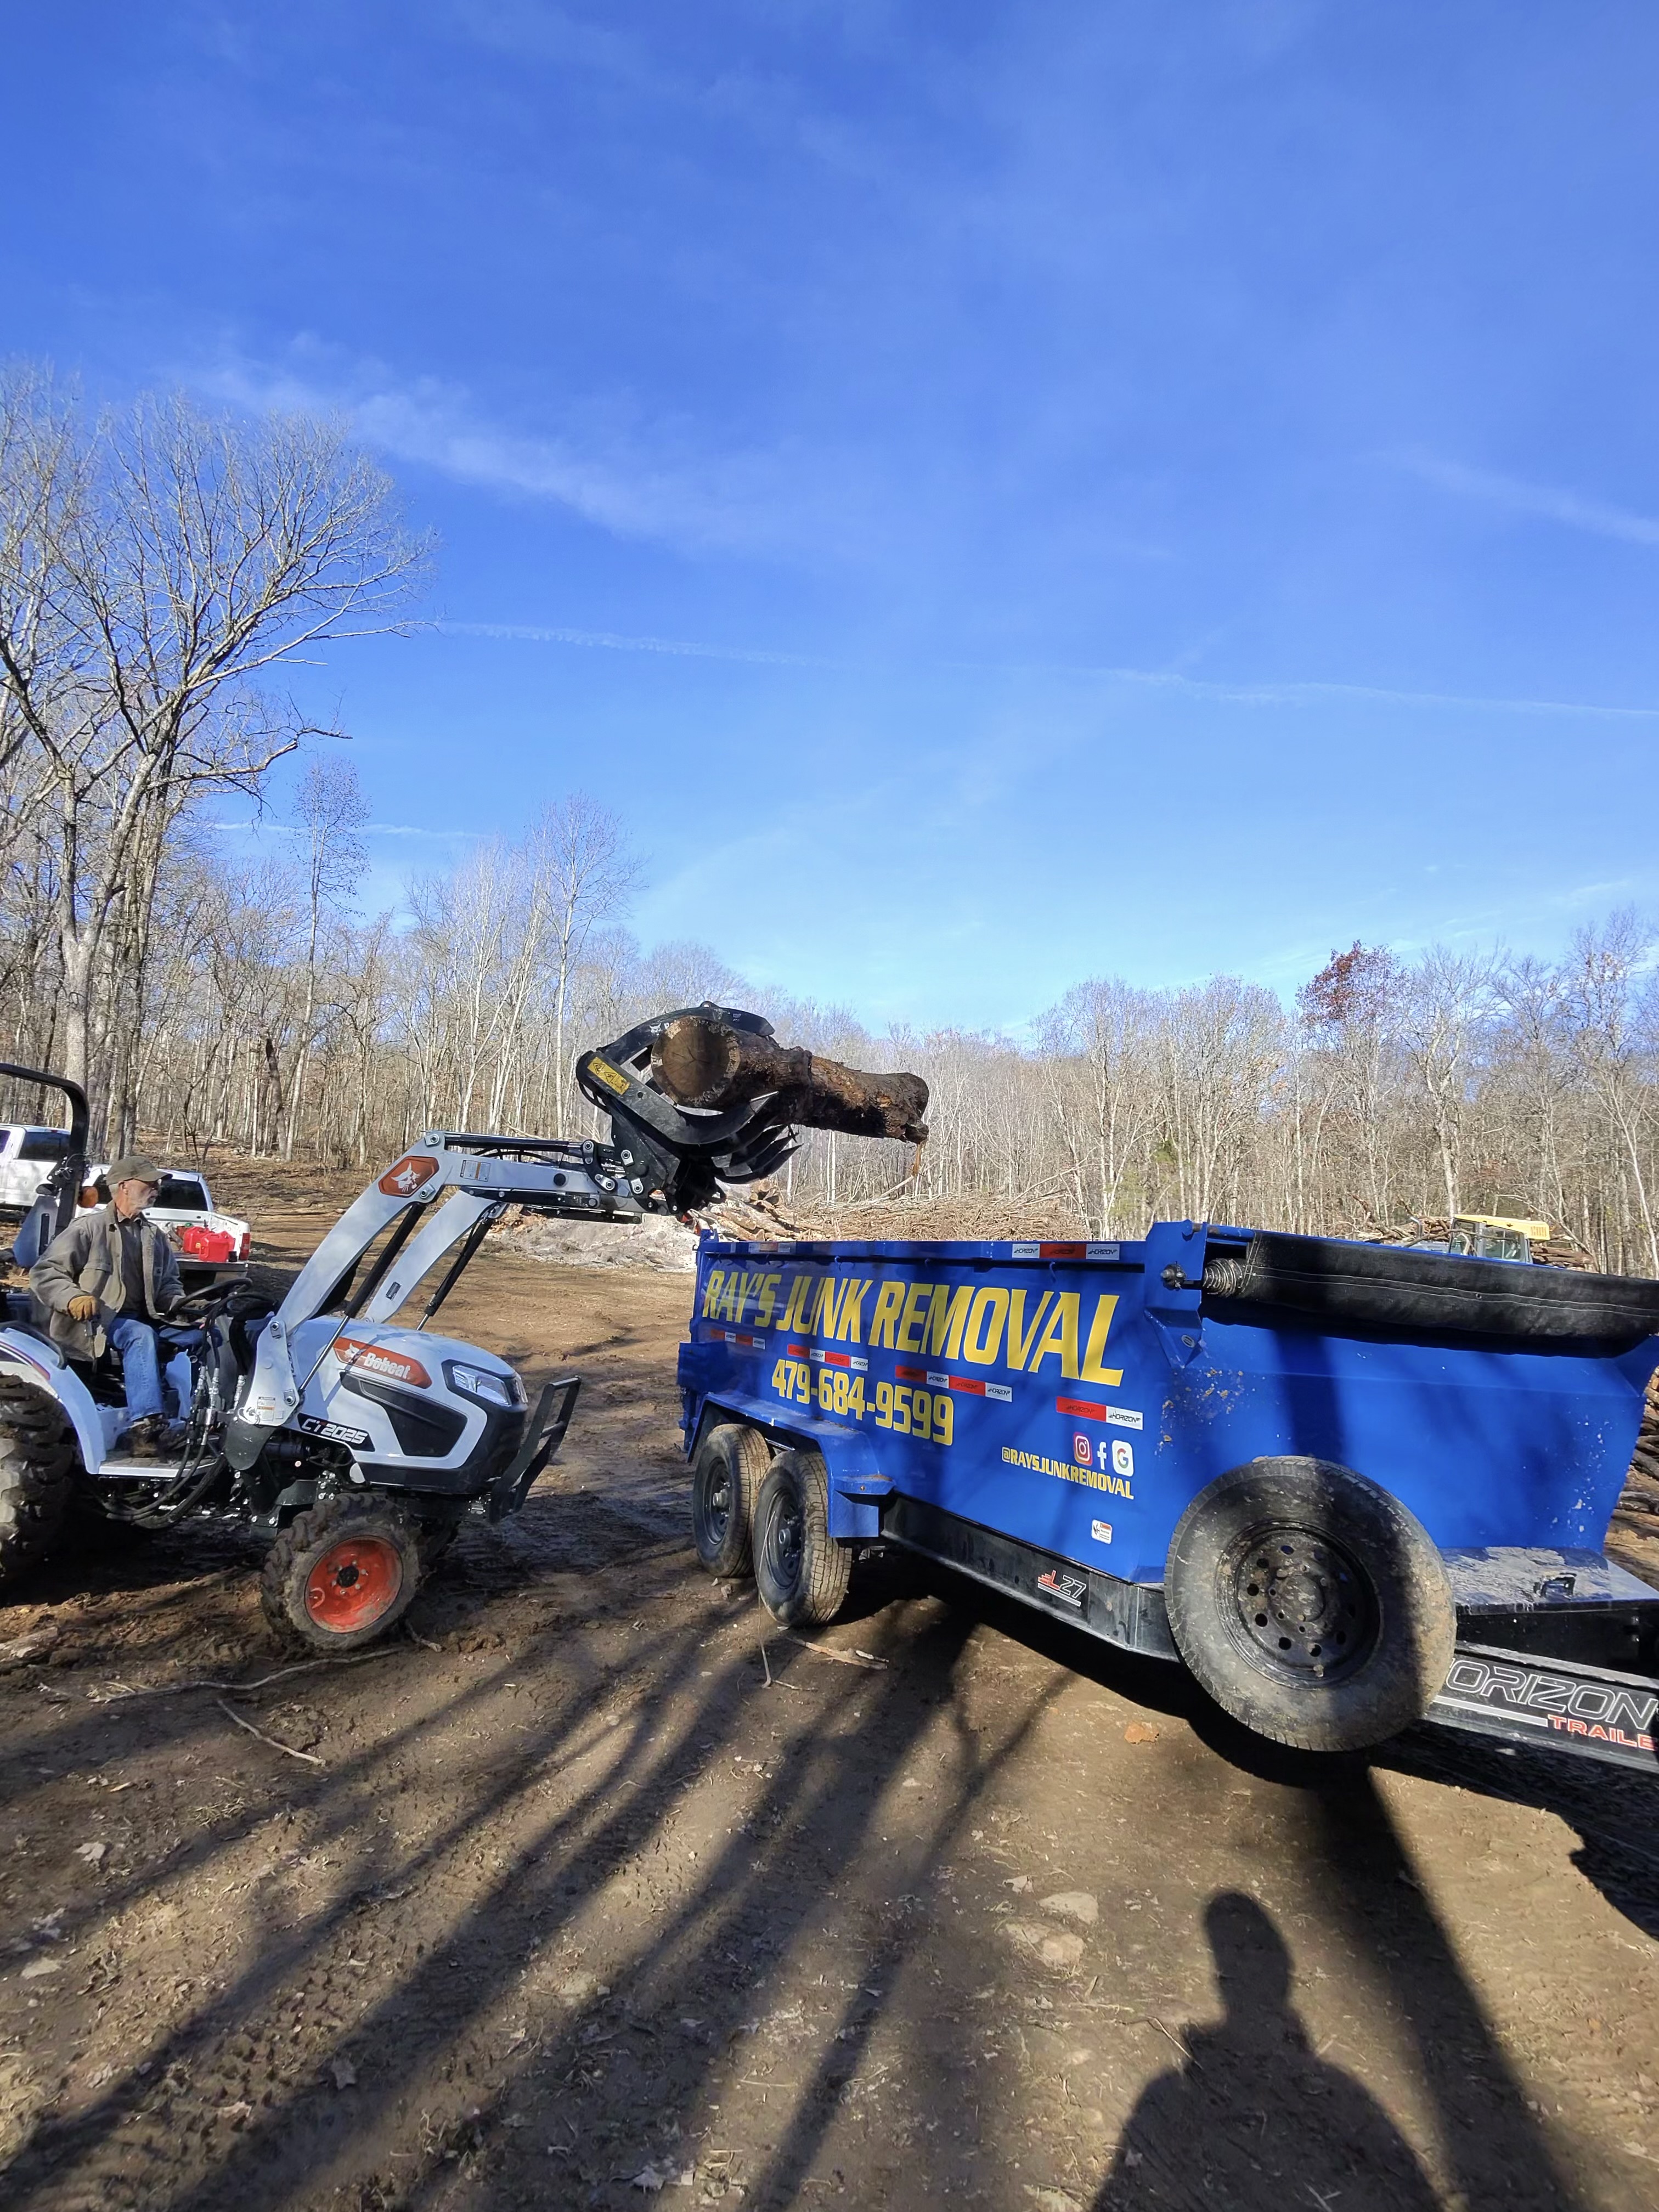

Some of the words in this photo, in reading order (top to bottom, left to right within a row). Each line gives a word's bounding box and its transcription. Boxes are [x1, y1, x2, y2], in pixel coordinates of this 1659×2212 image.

[702, 1270, 782, 1328] RAY'S
[775, 1276, 873, 1343] JUNK
[868, 1281, 1124, 1387] REMOVAL
[364, 1352, 410, 1379] Bobcat
[772, 1359, 954, 1446] 479-684-9599
[988, 1387, 1011, 1396] HORIZON
[1108, 1413, 1141, 1423] HORIZON
[1002, 1446, 1134, 1499] @RAYSJUNKREMOVAL
[1446, 1657, 1658, 1730] ORIZON
[1548, 1714, 1657, 1752] TRAILE
